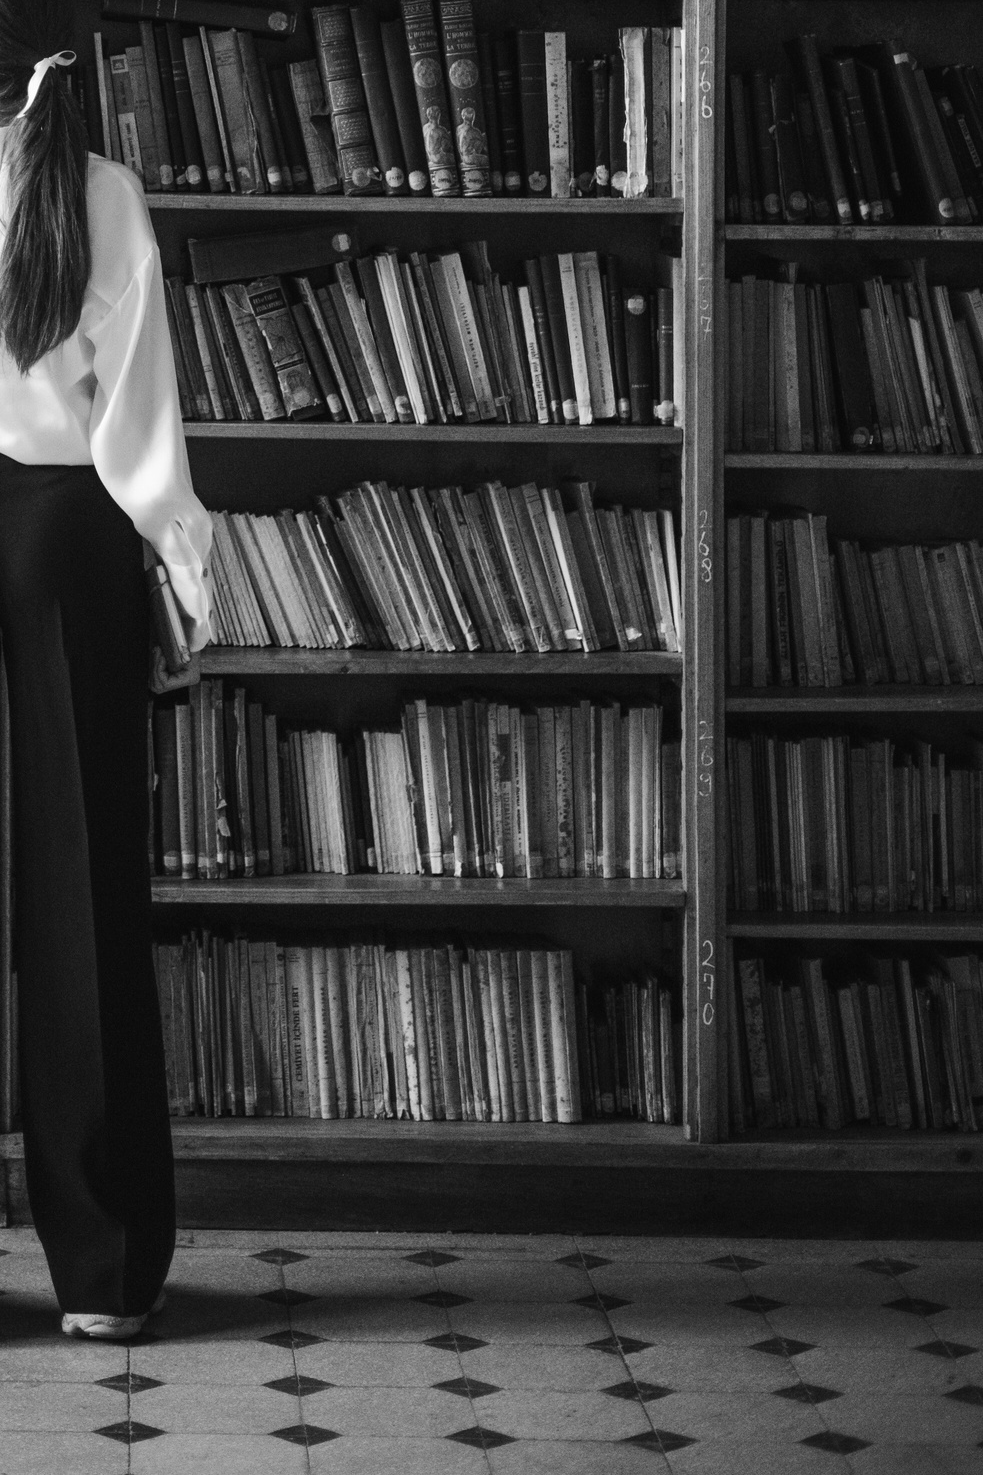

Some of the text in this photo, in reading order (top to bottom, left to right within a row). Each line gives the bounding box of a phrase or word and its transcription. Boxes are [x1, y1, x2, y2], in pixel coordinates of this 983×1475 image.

[699, 47, 713, 118] 266
[699, 510, 713, 582] 268
[702, 940, 715, 1025] 270
[291, 985, 303, 1082] CEMİYET İÇİNDE FERT
